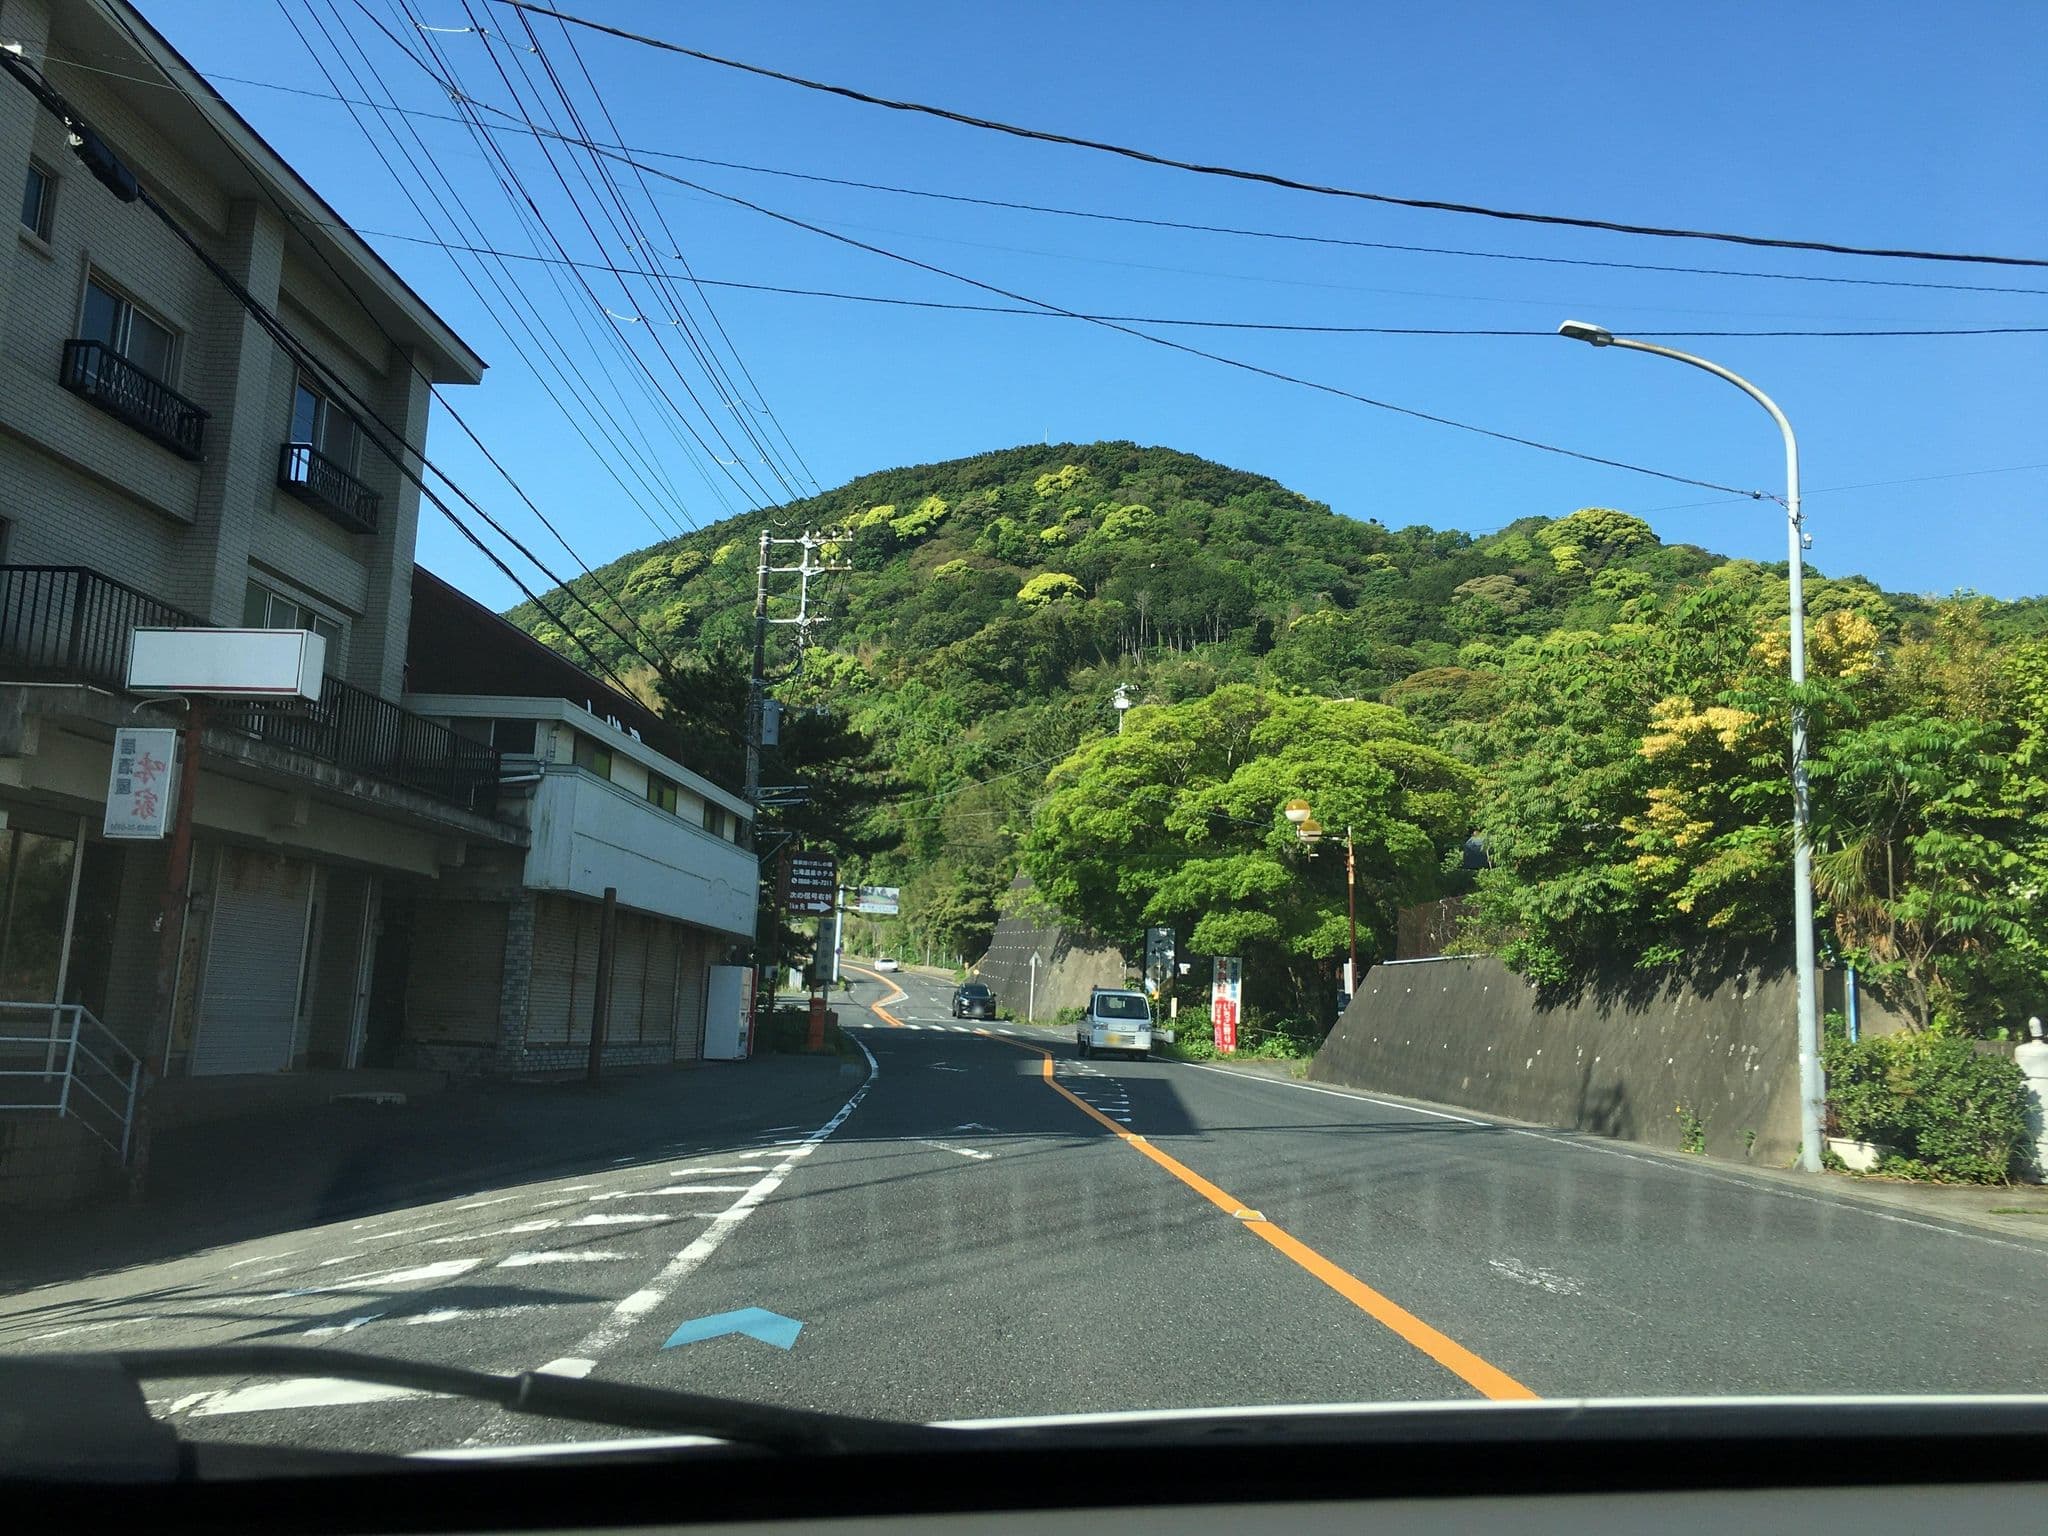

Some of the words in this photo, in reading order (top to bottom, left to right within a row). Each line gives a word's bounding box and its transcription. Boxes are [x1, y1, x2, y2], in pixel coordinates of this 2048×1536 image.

[789, 892, 832, 900] 次の信号右折
